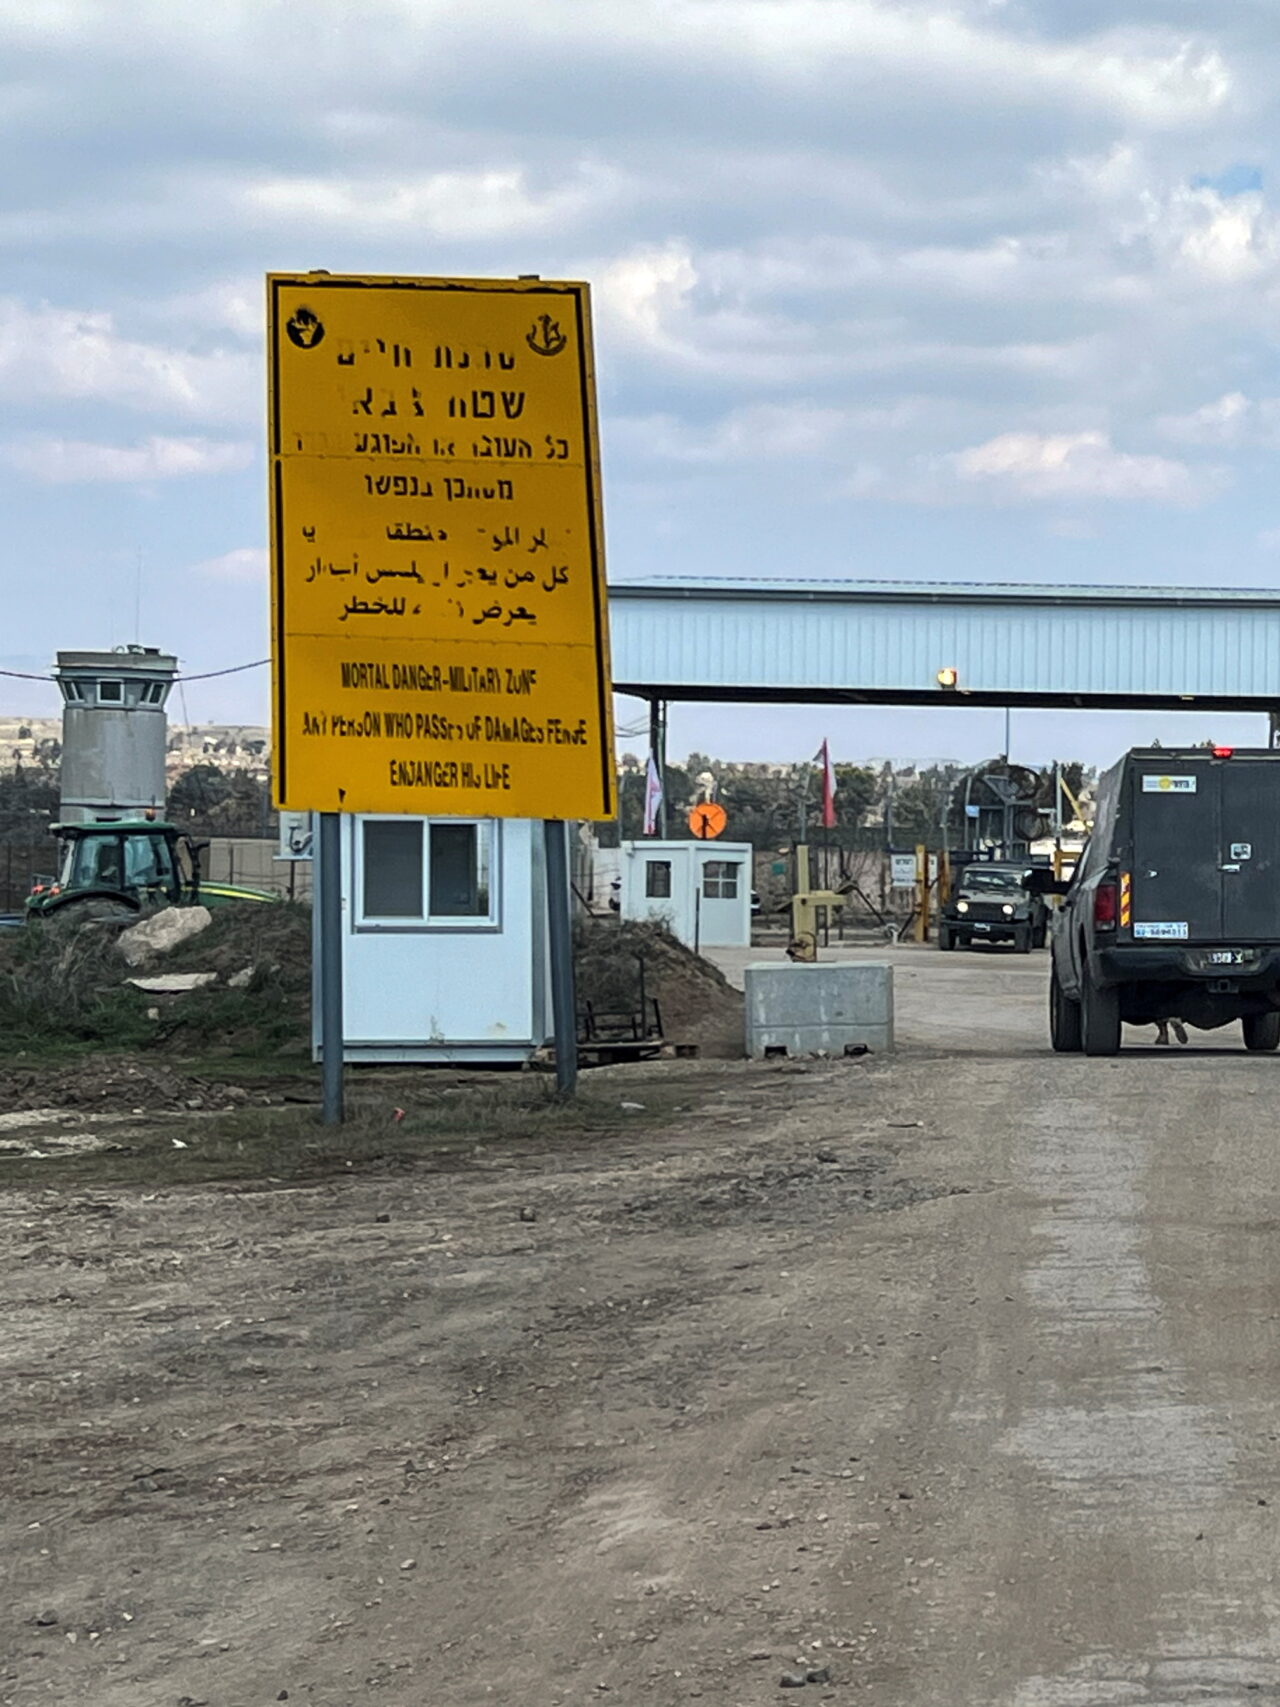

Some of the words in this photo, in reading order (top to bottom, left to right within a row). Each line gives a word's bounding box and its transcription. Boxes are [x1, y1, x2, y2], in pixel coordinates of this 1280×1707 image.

[542, 565, 570, 592] كل
[341, 662, 390, 690] MORTAL
[383, 712, 413, 739] WHO
